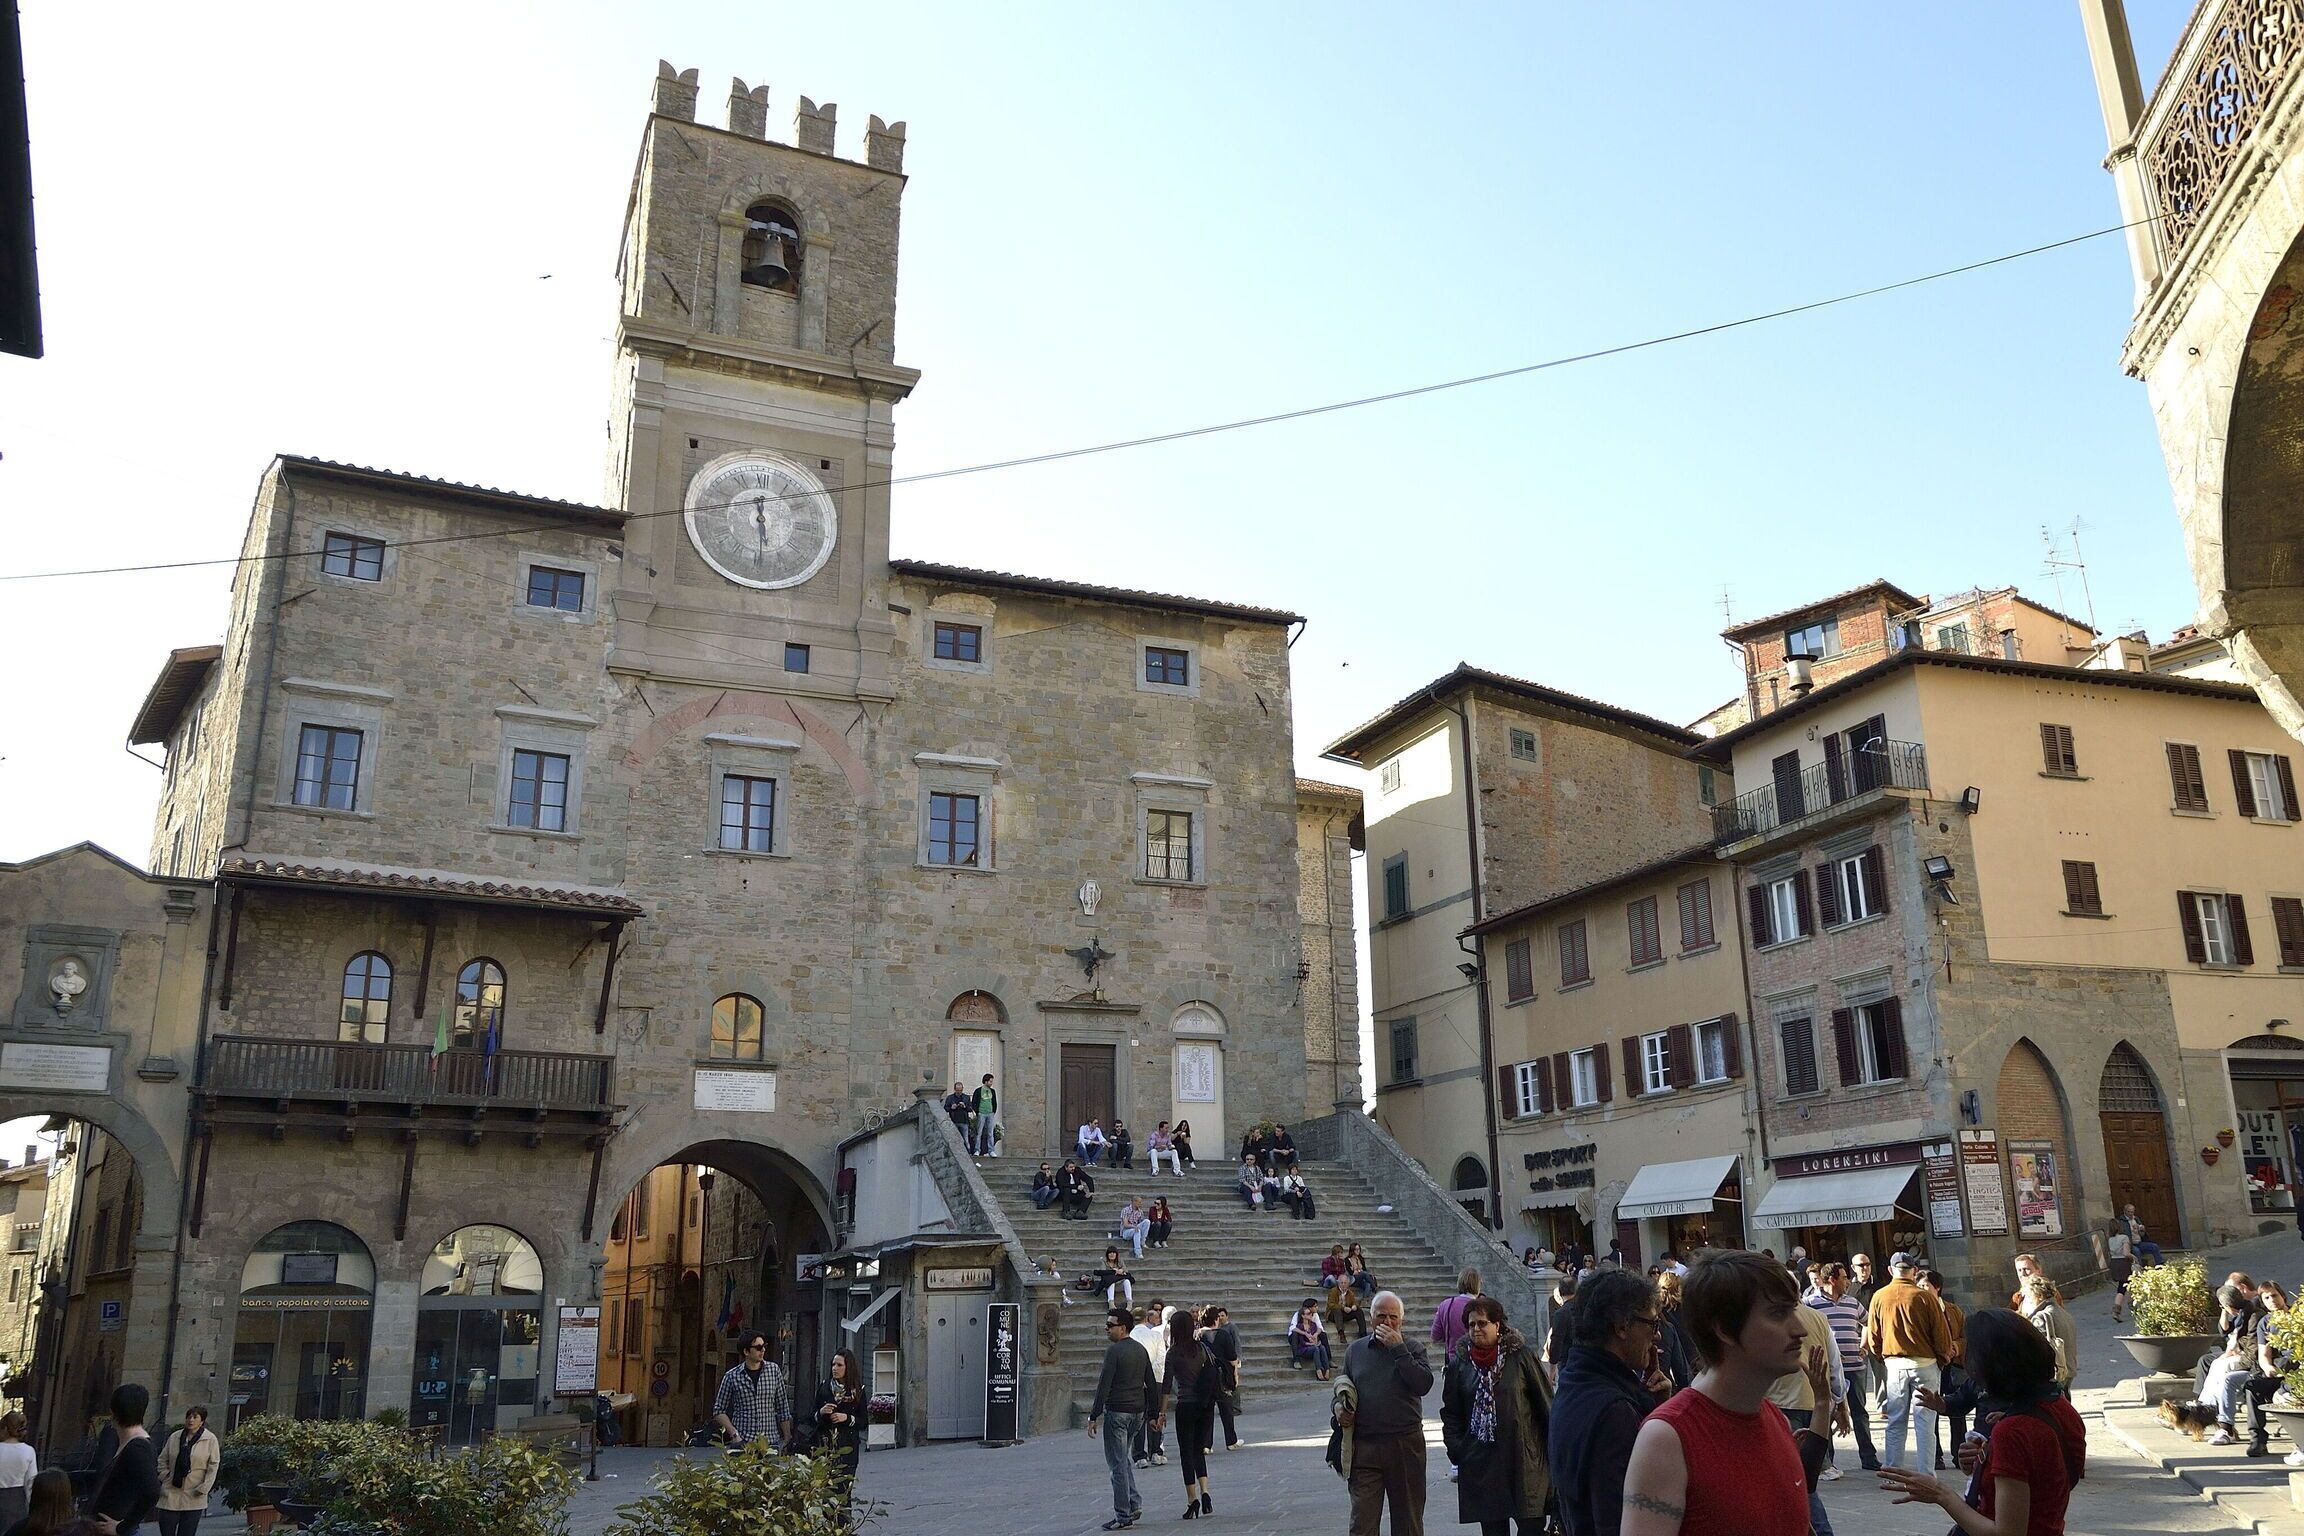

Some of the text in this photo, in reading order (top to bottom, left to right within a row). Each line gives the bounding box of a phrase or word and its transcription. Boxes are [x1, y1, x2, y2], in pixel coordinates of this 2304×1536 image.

[755, 473, 770, 490] XII
[1551, 1142, 1598, 1168] SPORT
[1802, 1150, 1889, 1172] LORENZINI
[1643, 1202, 1686, 1216] CALZATURE
[1766, 1213, 1809, 1228] CAPPELLI
[1827, 1208, 1878, 1224] OMBRELLI
[106, 1304, 117, 1317] P
[242, 1298, 370, 1309] banca popolare di cortona
[656, 1364, 666, 1374] 10
[419, 1381, 447, 1394] URP
